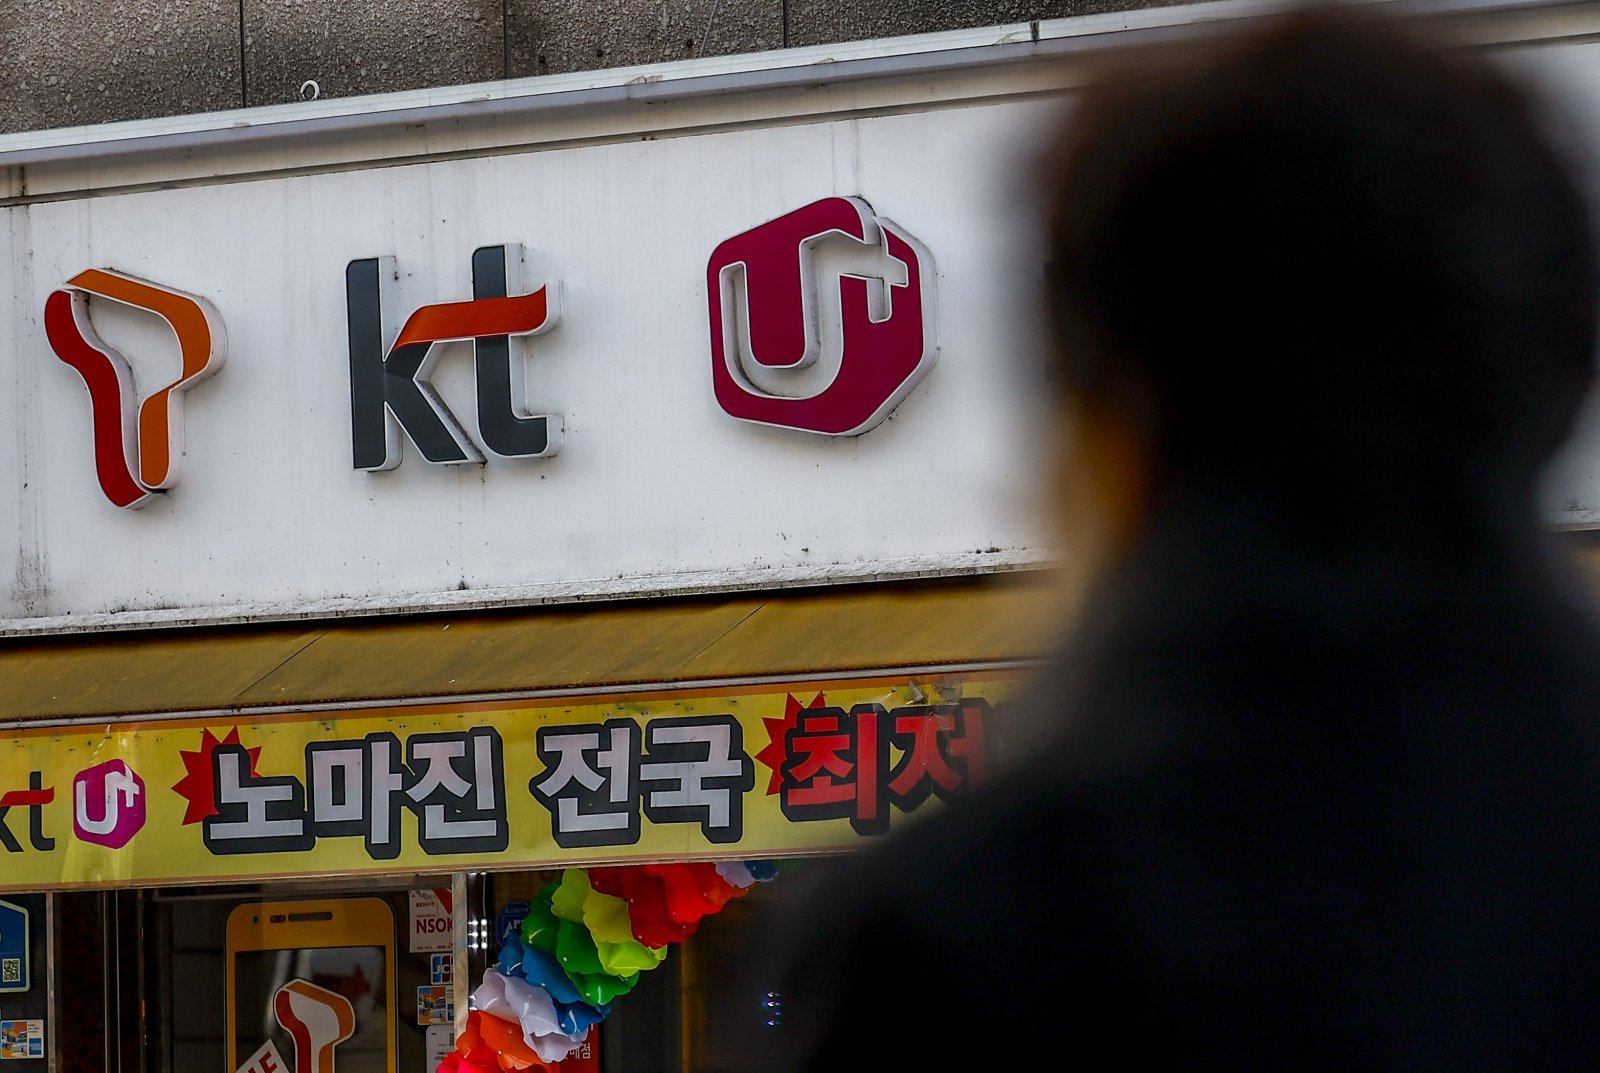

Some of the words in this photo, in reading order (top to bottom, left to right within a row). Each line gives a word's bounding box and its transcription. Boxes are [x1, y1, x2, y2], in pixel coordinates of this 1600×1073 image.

[346, 244, 552, 470] kt
[206, 731, 502, 851] 노마진
[534, 719, 747, 839] 전국
[784, 703, 987, 823] 최저
[565, 1042, 591, 1060] 매점
